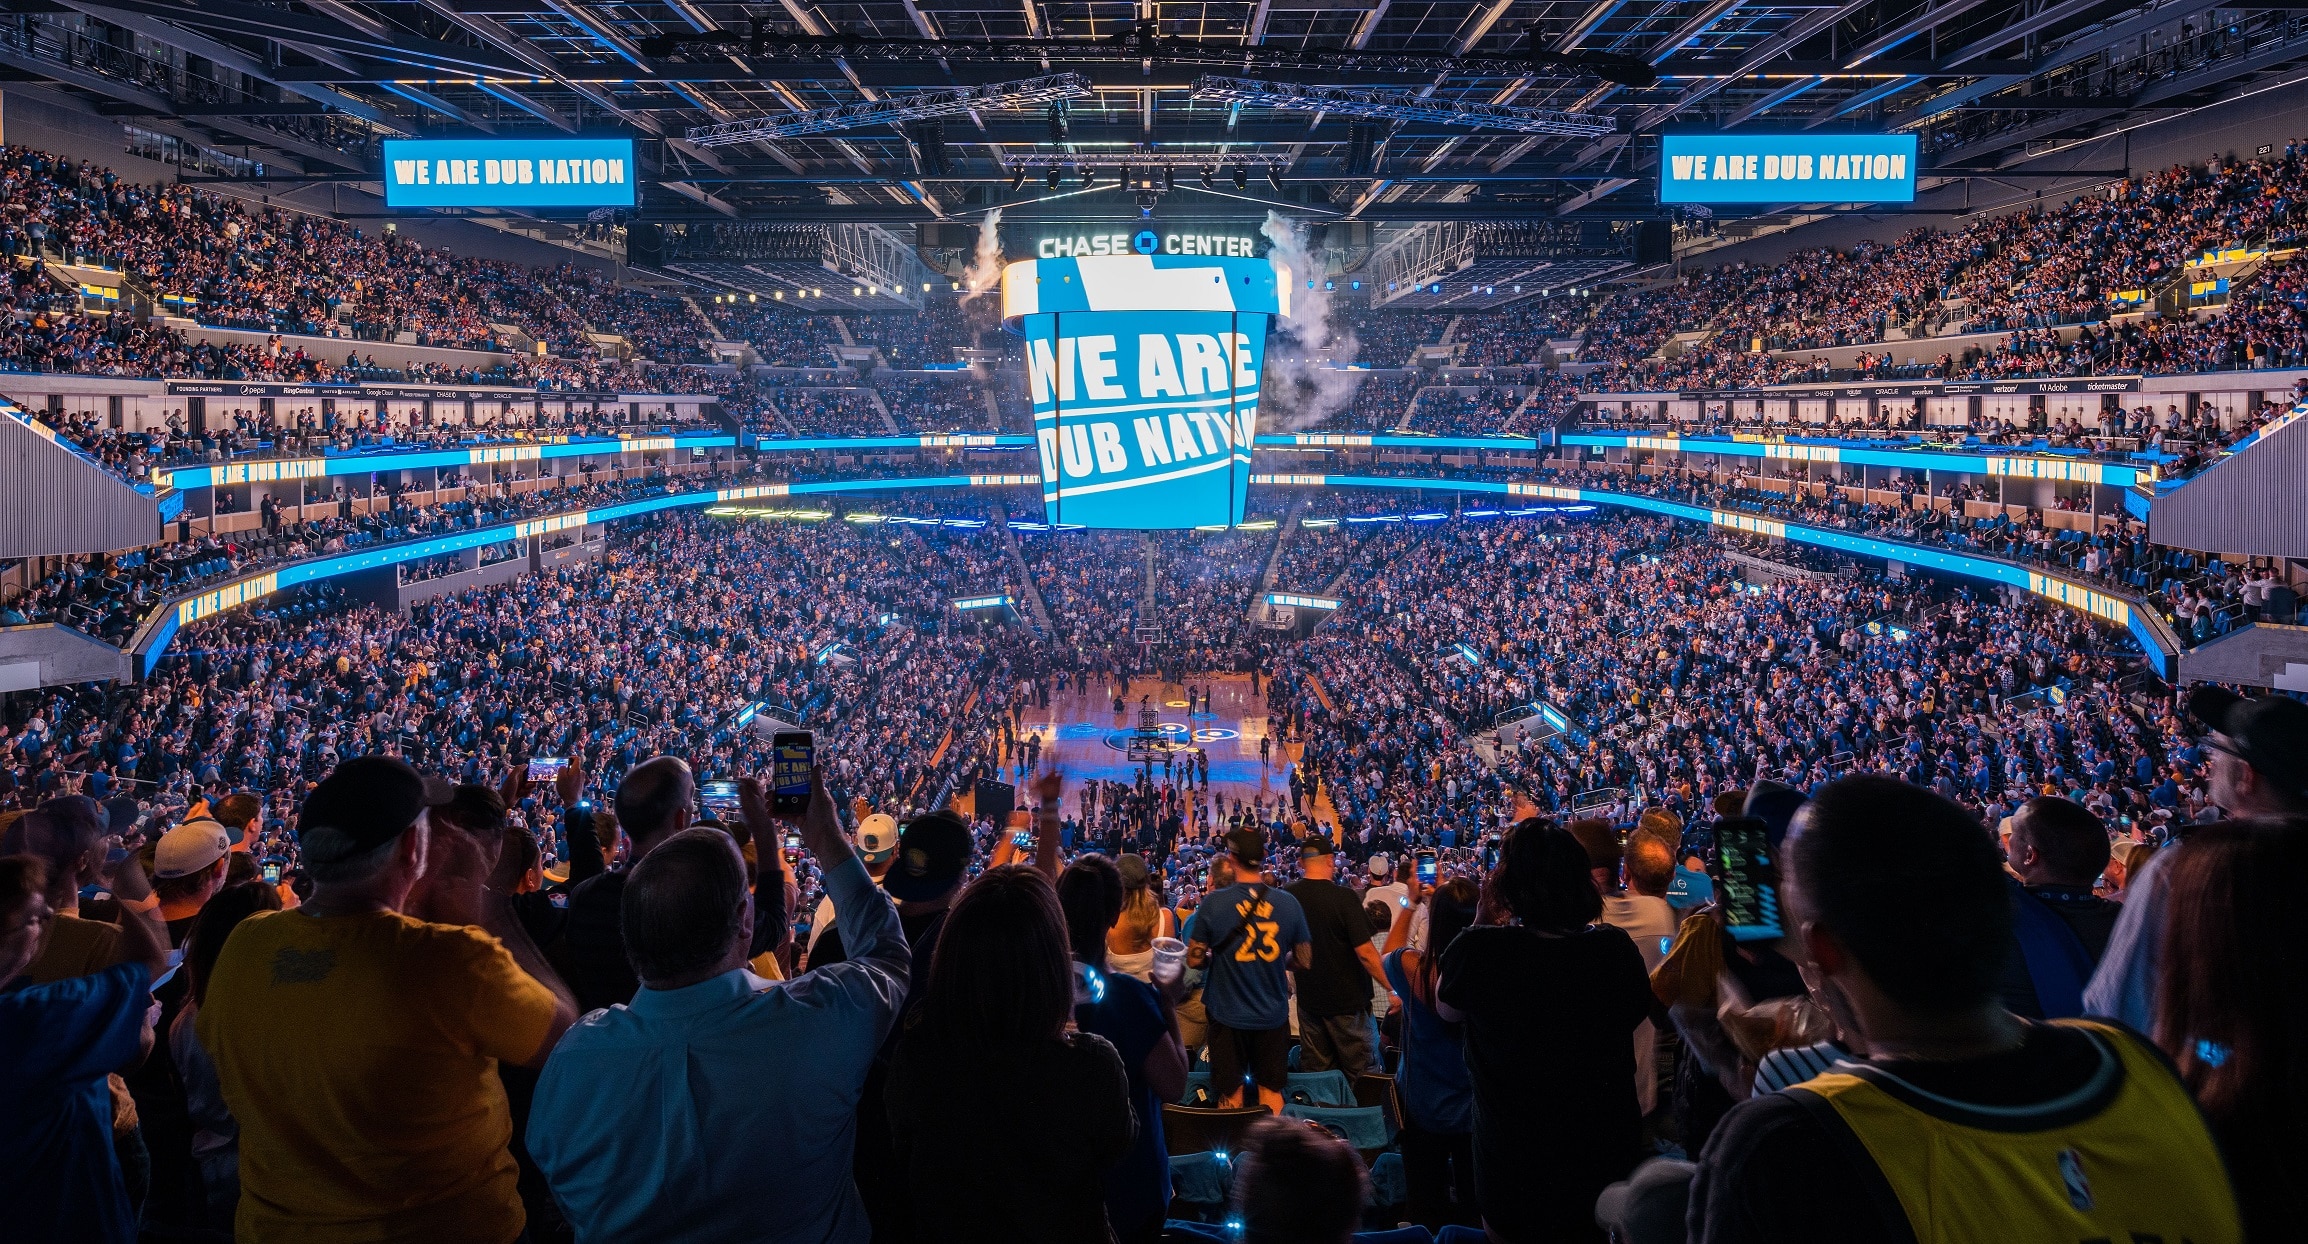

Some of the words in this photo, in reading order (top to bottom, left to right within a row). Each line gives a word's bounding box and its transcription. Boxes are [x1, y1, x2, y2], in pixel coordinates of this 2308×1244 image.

[2259, 146, 2270, 154] 221
[394, 160, 430, 184] WE
[436, 160, 479, 184] ARE
[485, 160, 534, 184] DUB
[539, 158, 624, 184] NATION
[1672, 155, 1706, 180] WE
[1713, 155, 1758, 180] ARE
[1764, 154, 1812, 180] DUB
[1819, 154, 1906, 180] NATION
[1039, 234, 1129, 258] CHASE
[1166, 234, 1253, 257] CENTER
[1026, 334, 1126, 404] WE
[1138, 332, 1256, 398] ARE
[1993, 384, 2016, 392] verizon
[1037, 422, 1128, 484] DUB
[1133, 407, 1256, 467] NATION
[2008, 459, 2034, 478] ARE
[1235, 922, 1280, 962] 23
